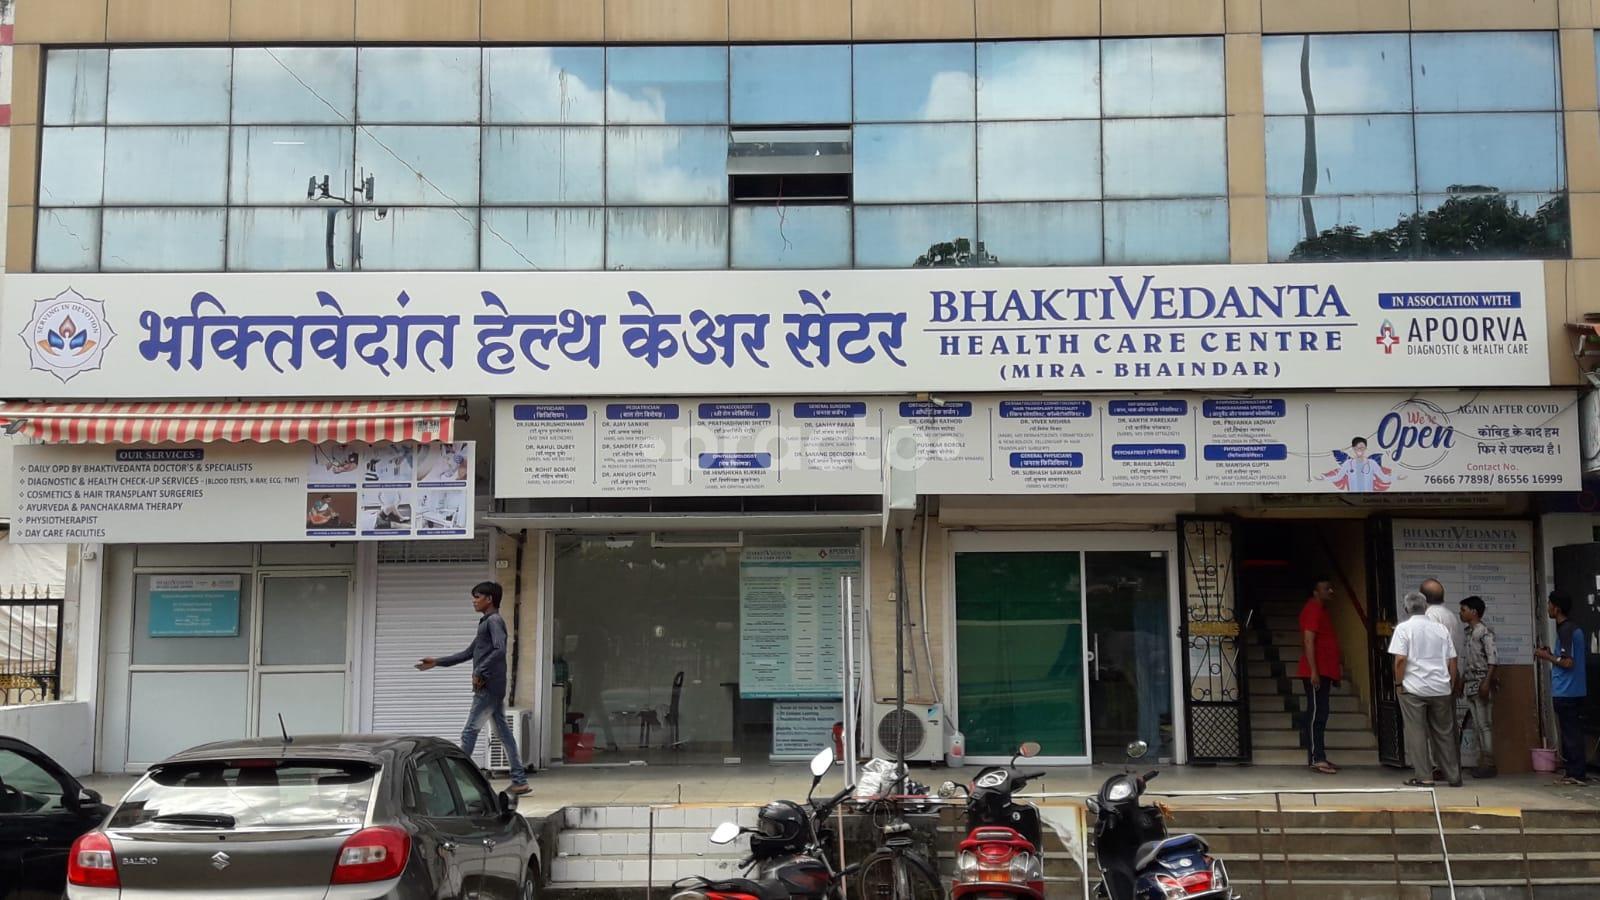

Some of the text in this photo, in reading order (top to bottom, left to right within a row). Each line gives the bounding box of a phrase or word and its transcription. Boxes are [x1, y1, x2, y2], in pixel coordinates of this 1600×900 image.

[929, 275, 1351, 323] BHAKTIVEDANTA
[1392, 295, 1511, 307] IN ASSOCIATION WITH
[37, 306, 60, 334] SERVING
[71, 304, 99, 334] DEVOTION
[139, 289, 907, 376] भक्तिवेदांत हेल्थ केअर सेंटर
[1408, 317, 1527, 342] APOORVA
[940, 331, 1342, 356] HEALTH CARE CENTRE
[1407, 344, 1529, 355] DIAGNOSTIC & HEALTH CARE
[1000, 362, 1086, 380] (MIRA
[1115, 361, 1281, 378] BHAINDAR)
[1457, 405, 1559, 415] AGAIN AFTER COVID
[1512, 425, 1522, 436] के
[1524, 428, 1542, 437] बाद
[1544, 428, 1559, 437] हम
[1377, 412, 1456, 462] Open
[1478, 442, 1496, 455] फिर
[1498, 442, 1507, 455] से
[1547, 442, 1554, 455] है
[120, 451, 195, 460] OUR SERVICES
[28, 463, 253, 473] DAILY OPD BY BHAKTIVEDANTA DOCTOR'S & SPECIALISTS
[1467, 463, 1519, 471] Contact No.
[28, 477, 78, 486] DIAGNOSTIC
[79, 477, 85, 486] &
[87, 477, 118, 486] HEALTH
[120, 477, 159, 486] CHECK-UP
[161, 477, 199, 486] SERVICES
[1424, 474, 1563, 486] 76666 77898/ 86556 16999
[27, 490, 203, 499] COSMETICS & HAIR TRANSPLANT SURGERIES
[26, 502, 183, 512] AYURVEDA & PANCHAKARMA THERAPY
[26, 516, 98, 525] PHYSIOTHERAPIST
[25, 529, 106, 538] DAY CARE FACILITIES
[122, 857, 158, 865] BALENO
